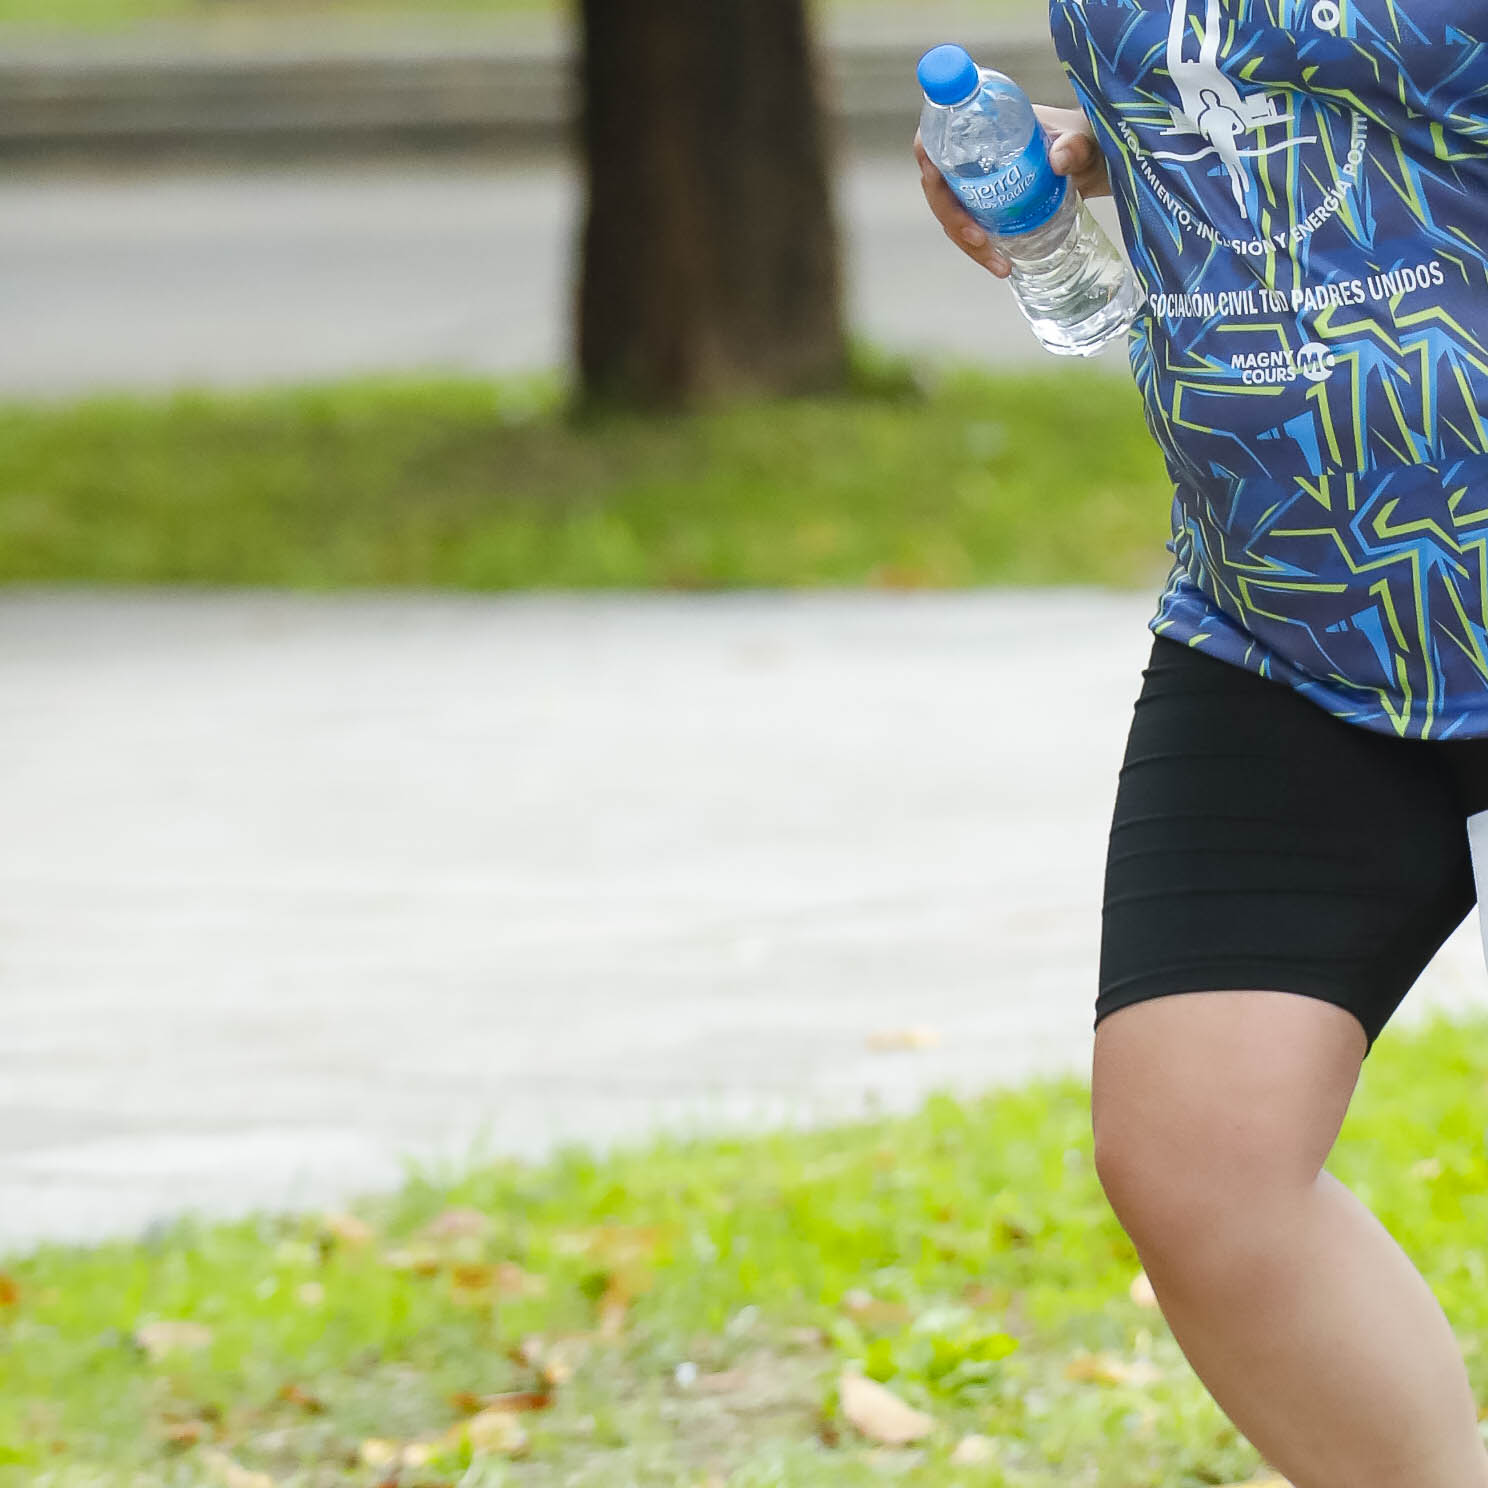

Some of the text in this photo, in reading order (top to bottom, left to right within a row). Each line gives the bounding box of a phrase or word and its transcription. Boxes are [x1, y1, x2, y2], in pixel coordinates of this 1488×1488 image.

[960, 164, 1022, 201] Sierra
[1117, 121, 1192, 231] MOVIMIENTO,
[1273, 231, 1287, 249] Y
[1290, 179, 1354, 243] ENERGÍA
[1218, 290, 1259, 317] CIVIL
[1291, 279, 1366, 313] PADRES
[1367, 261, 1444, 301] UNIDOS
[1231, 350, 1294, 369] MAGNY
[1241, 367, 1297, 385] COURS
